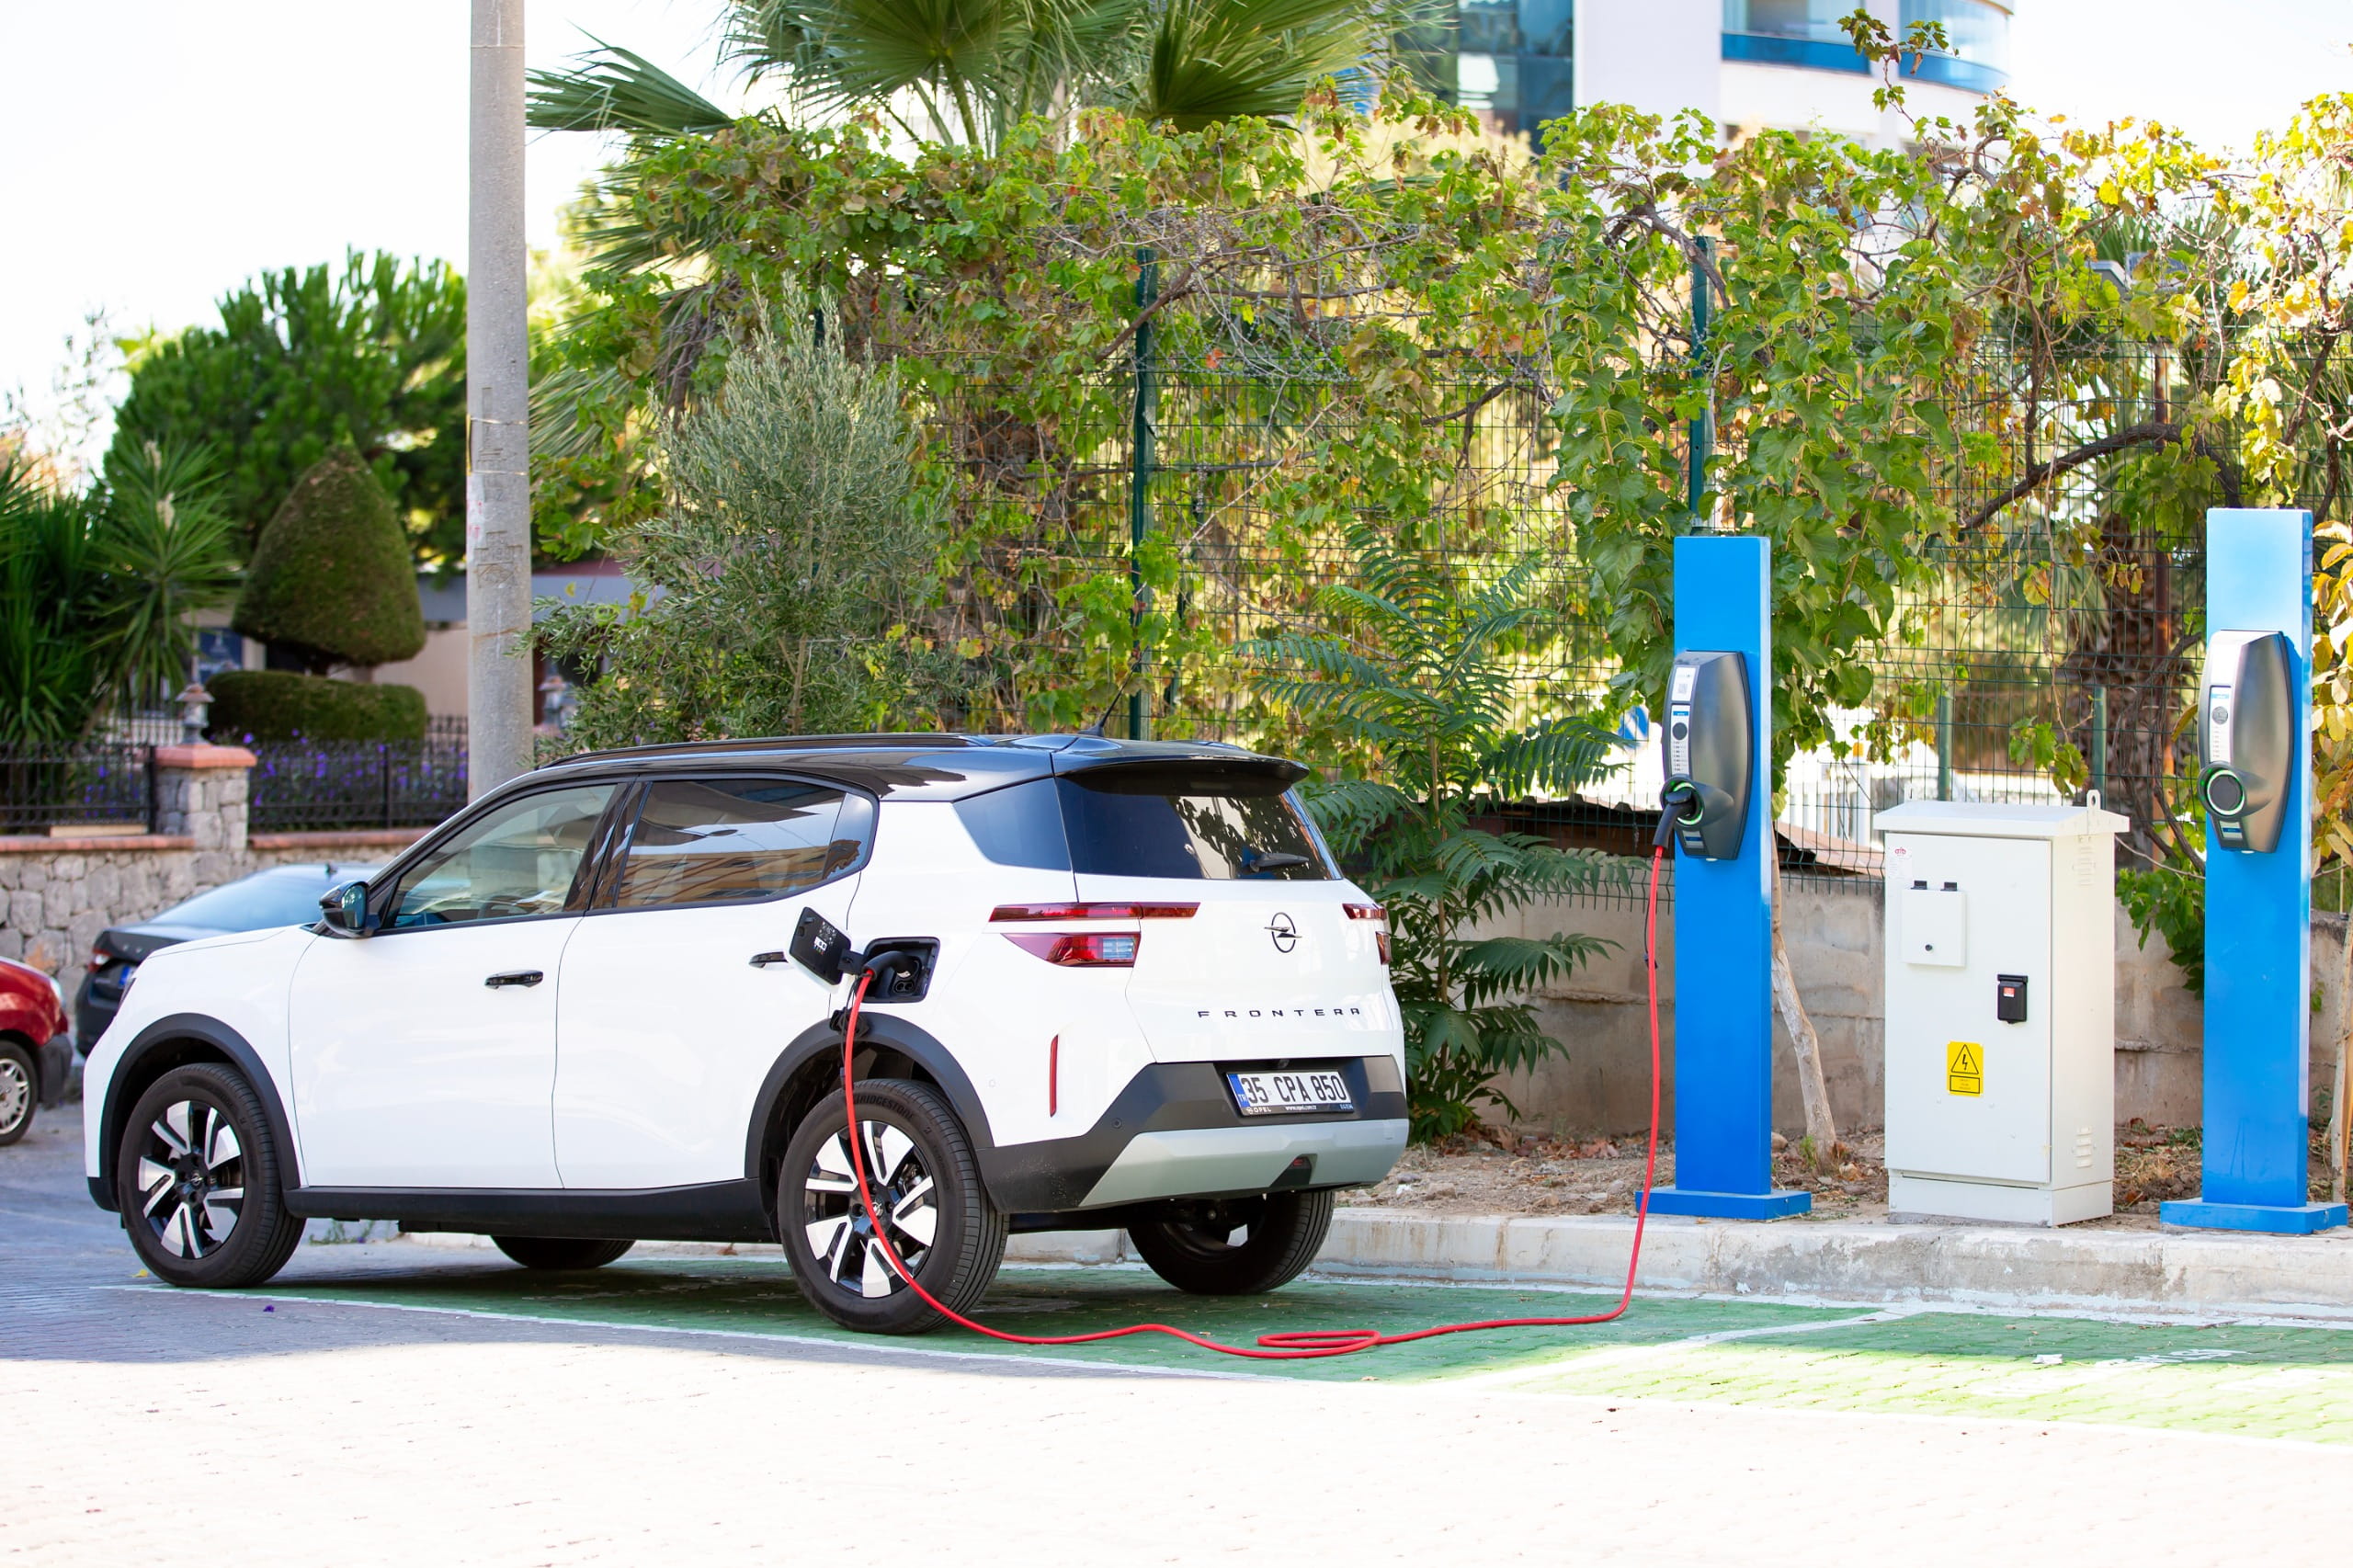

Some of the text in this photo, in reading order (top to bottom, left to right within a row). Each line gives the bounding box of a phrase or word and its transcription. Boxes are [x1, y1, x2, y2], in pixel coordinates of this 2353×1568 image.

[1198, 1007, 1360, 1018] FRONTERA
[1242, 1075, 1347, 1103] 35 CPA 850
[1254, 1105, 1272, 1114] OPEL
